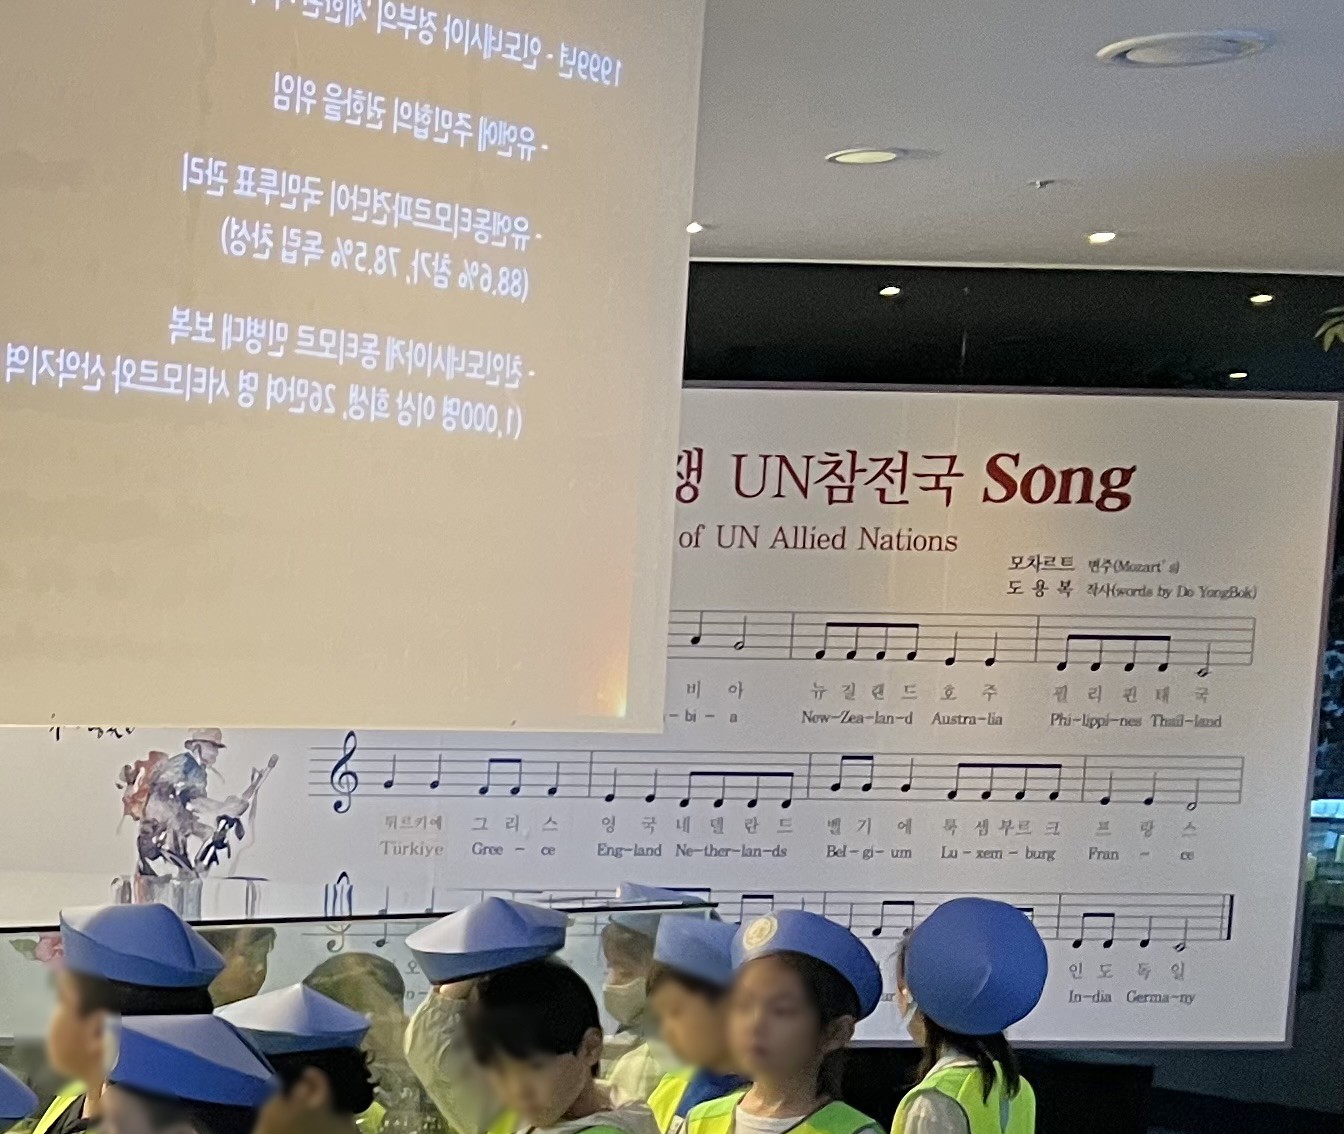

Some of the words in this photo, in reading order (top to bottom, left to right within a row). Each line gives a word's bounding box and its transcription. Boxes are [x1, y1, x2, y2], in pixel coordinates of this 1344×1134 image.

[731, 448, 964, 508] UN참전국
[981, 451, 1137, 512] Song
[678, 523, 705, 549] of
[716, 525, 760, 549] UN
[769, 525, 846, 551] Allied
[857, 526, 958, 552] Nations
[1008, 554, 1075, 573] 모차르트
[728, 680, 744, 700] 아
[983, 684, 998, 702] 주
[472, 817, 488, 831] 그
[542, 817, 558, 831] 스
[857, 818, 871, 835] 기
[380, 841, 444, 857] Türkiye
